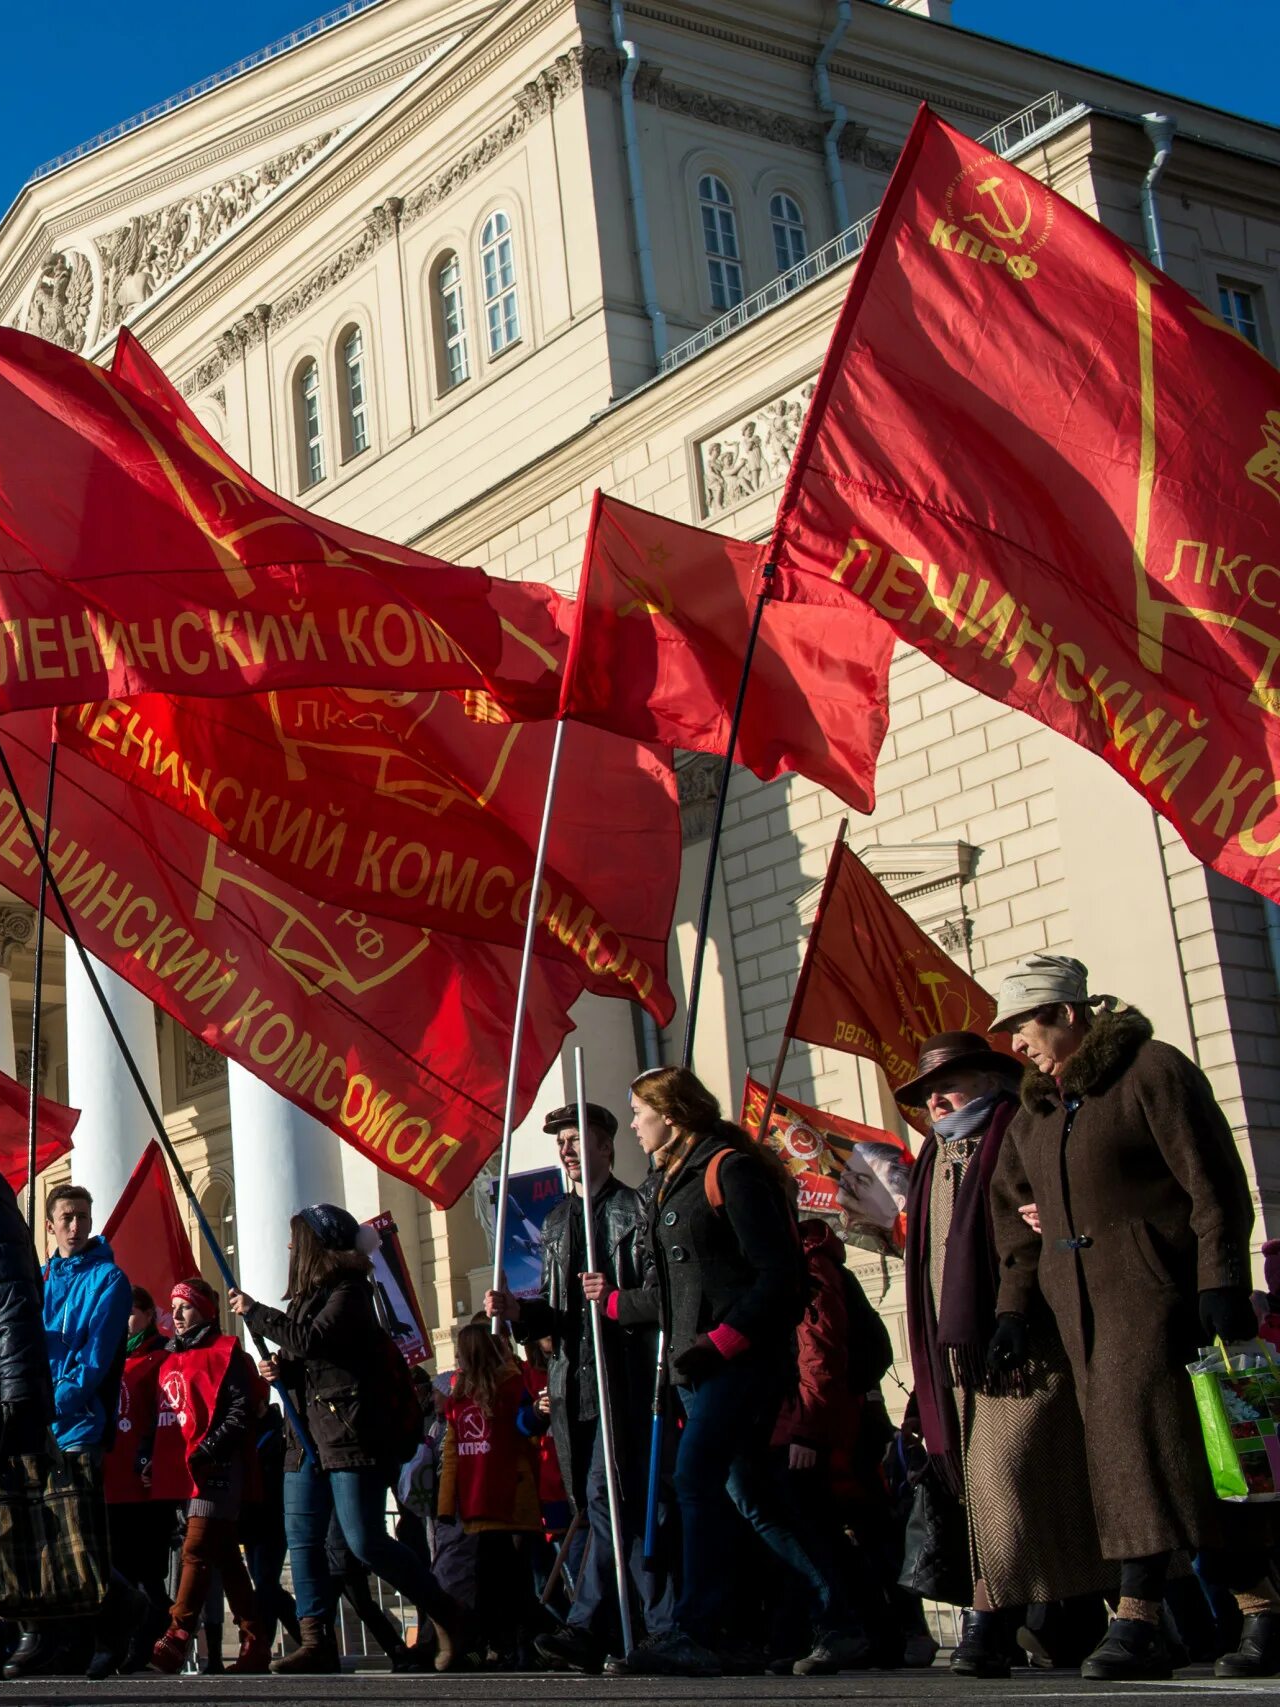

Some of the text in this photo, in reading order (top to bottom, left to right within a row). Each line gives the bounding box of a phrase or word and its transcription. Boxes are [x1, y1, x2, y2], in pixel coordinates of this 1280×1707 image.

[929, 218, 1038, 280] КПРФ
[830, 538, 1208, 803] ЛЕНИНСКИЙ
[354, 831, 653, 998] КОМСОМОЛ
[222, 987, 462, 1186] КОМСОМОЛ
[532, 1178, 559, 1201] ДА!
[158, 1411, 187, 1428] ПРФ
[458, 1440, 490, 1456] КПРФ
